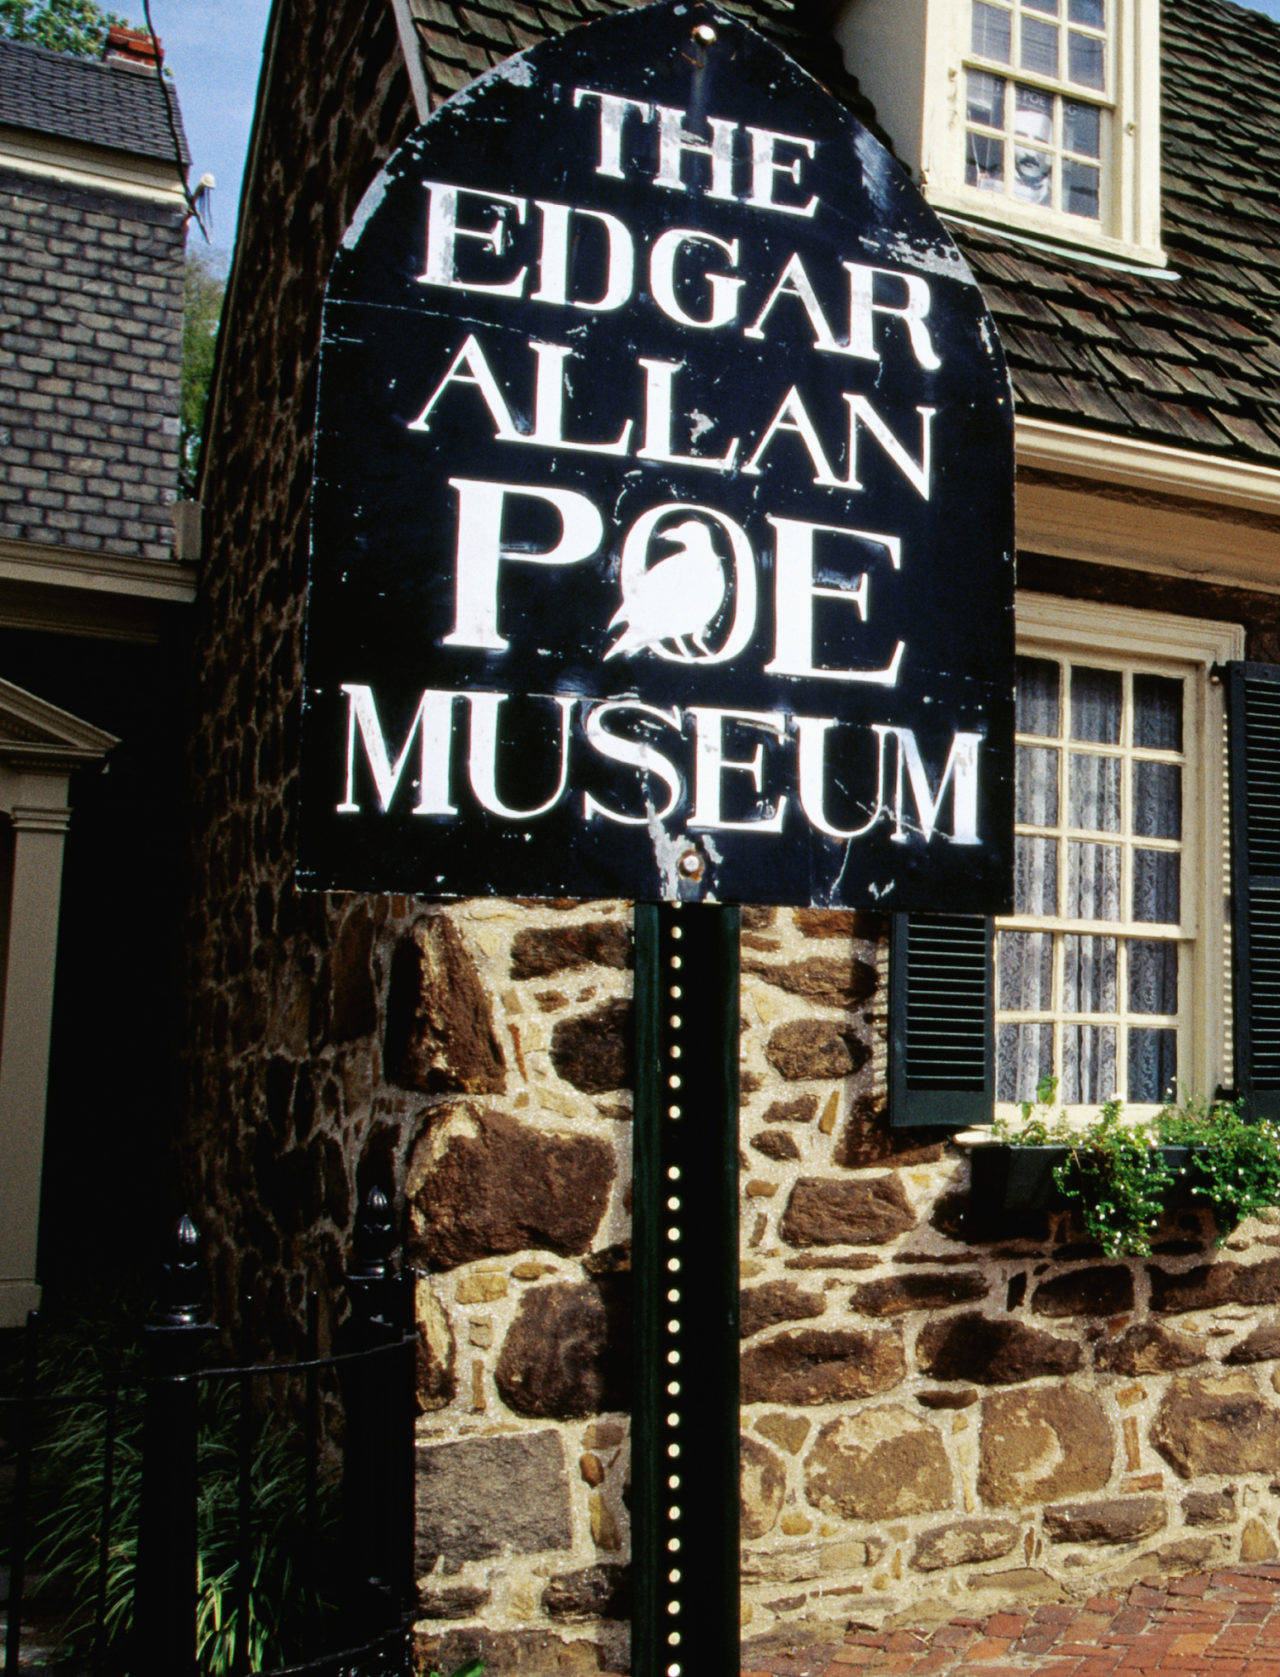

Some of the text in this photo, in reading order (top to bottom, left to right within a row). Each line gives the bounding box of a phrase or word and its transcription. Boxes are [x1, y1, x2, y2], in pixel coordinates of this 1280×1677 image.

[573, 87, 819, 217] THE
[415, 180, 942, 372] EDGAR
[406, 334, 937, 502] ALLAN
[442, 477, 905, 686] POE
[335, 683, 983, 846] MUSEUM
